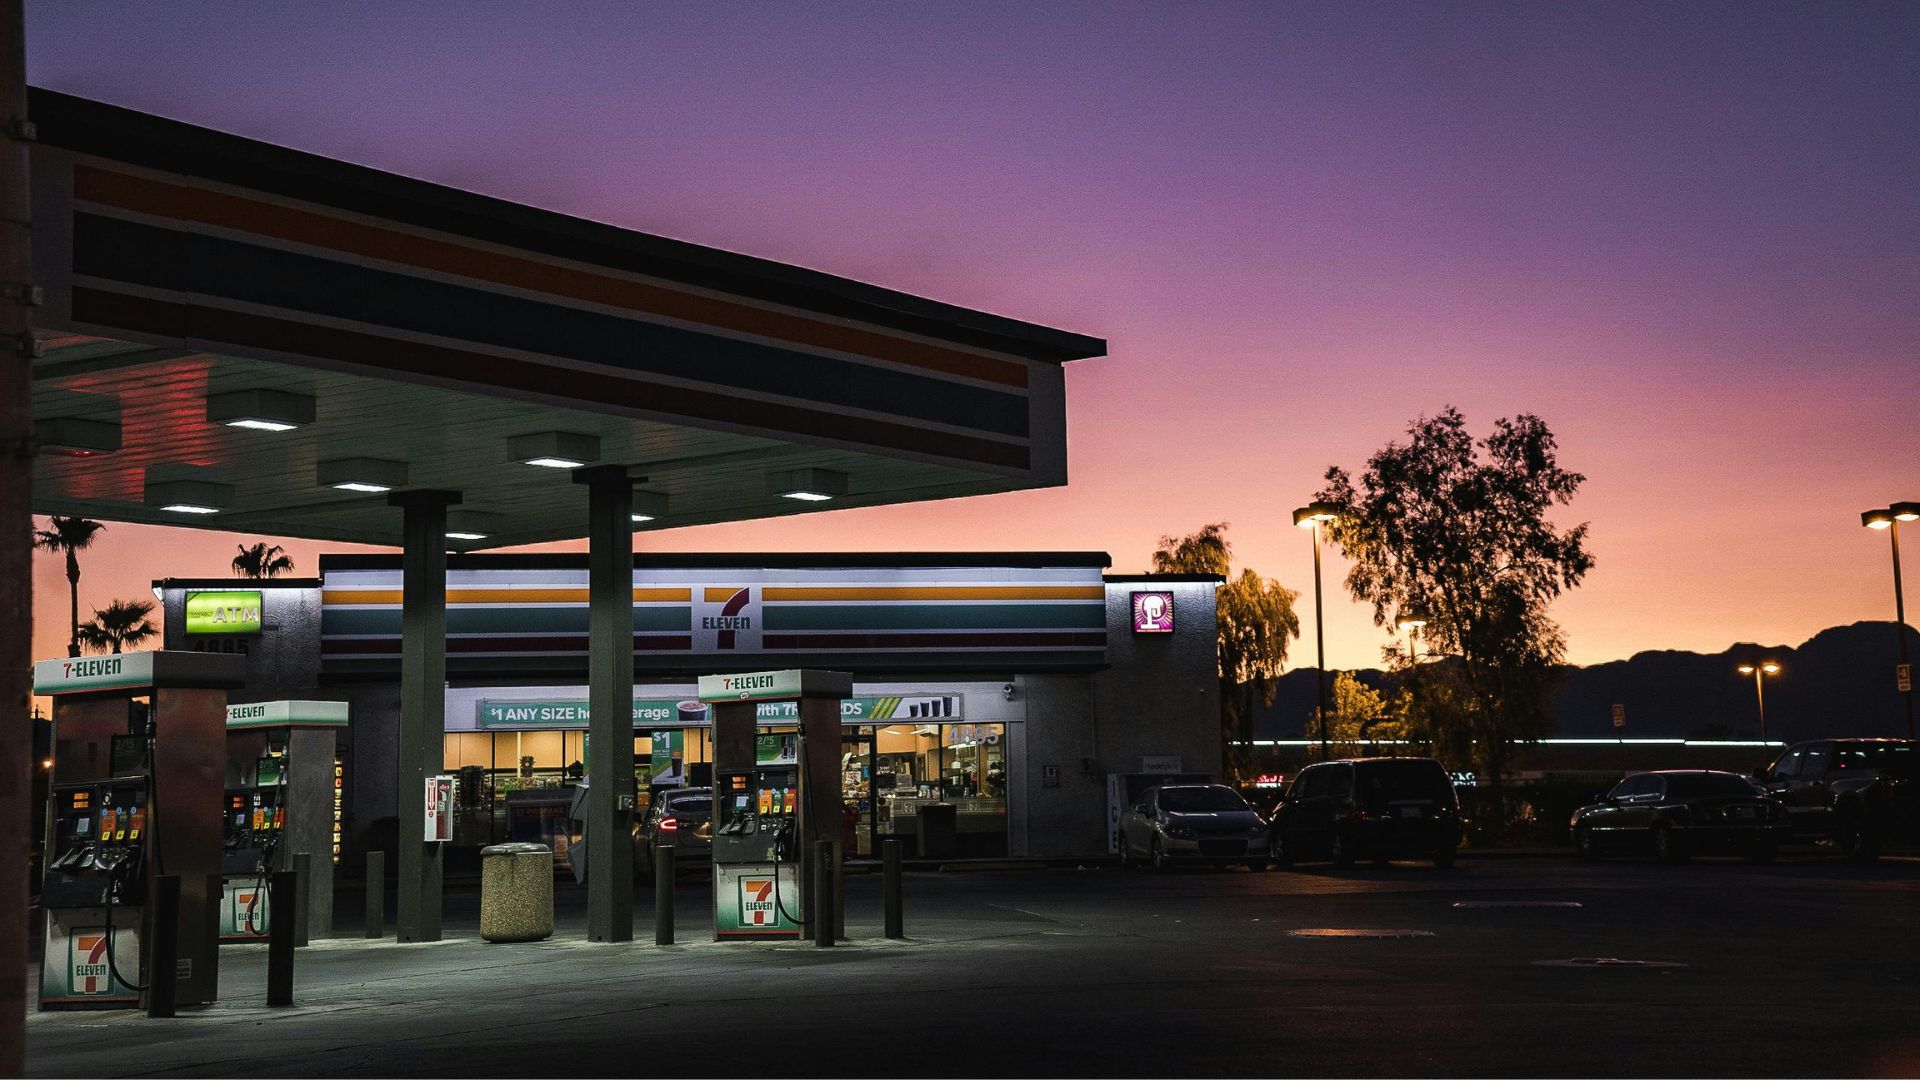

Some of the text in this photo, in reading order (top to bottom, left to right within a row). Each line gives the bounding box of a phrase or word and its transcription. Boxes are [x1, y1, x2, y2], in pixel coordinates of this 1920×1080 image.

[213, 607, 259, 623] ATM
[490, 708, 503, 720] $1
[505, 708, 538, 720] ANY
[540, 707, 575, 720] SIZE
[653, 731, 670, 748] $1
